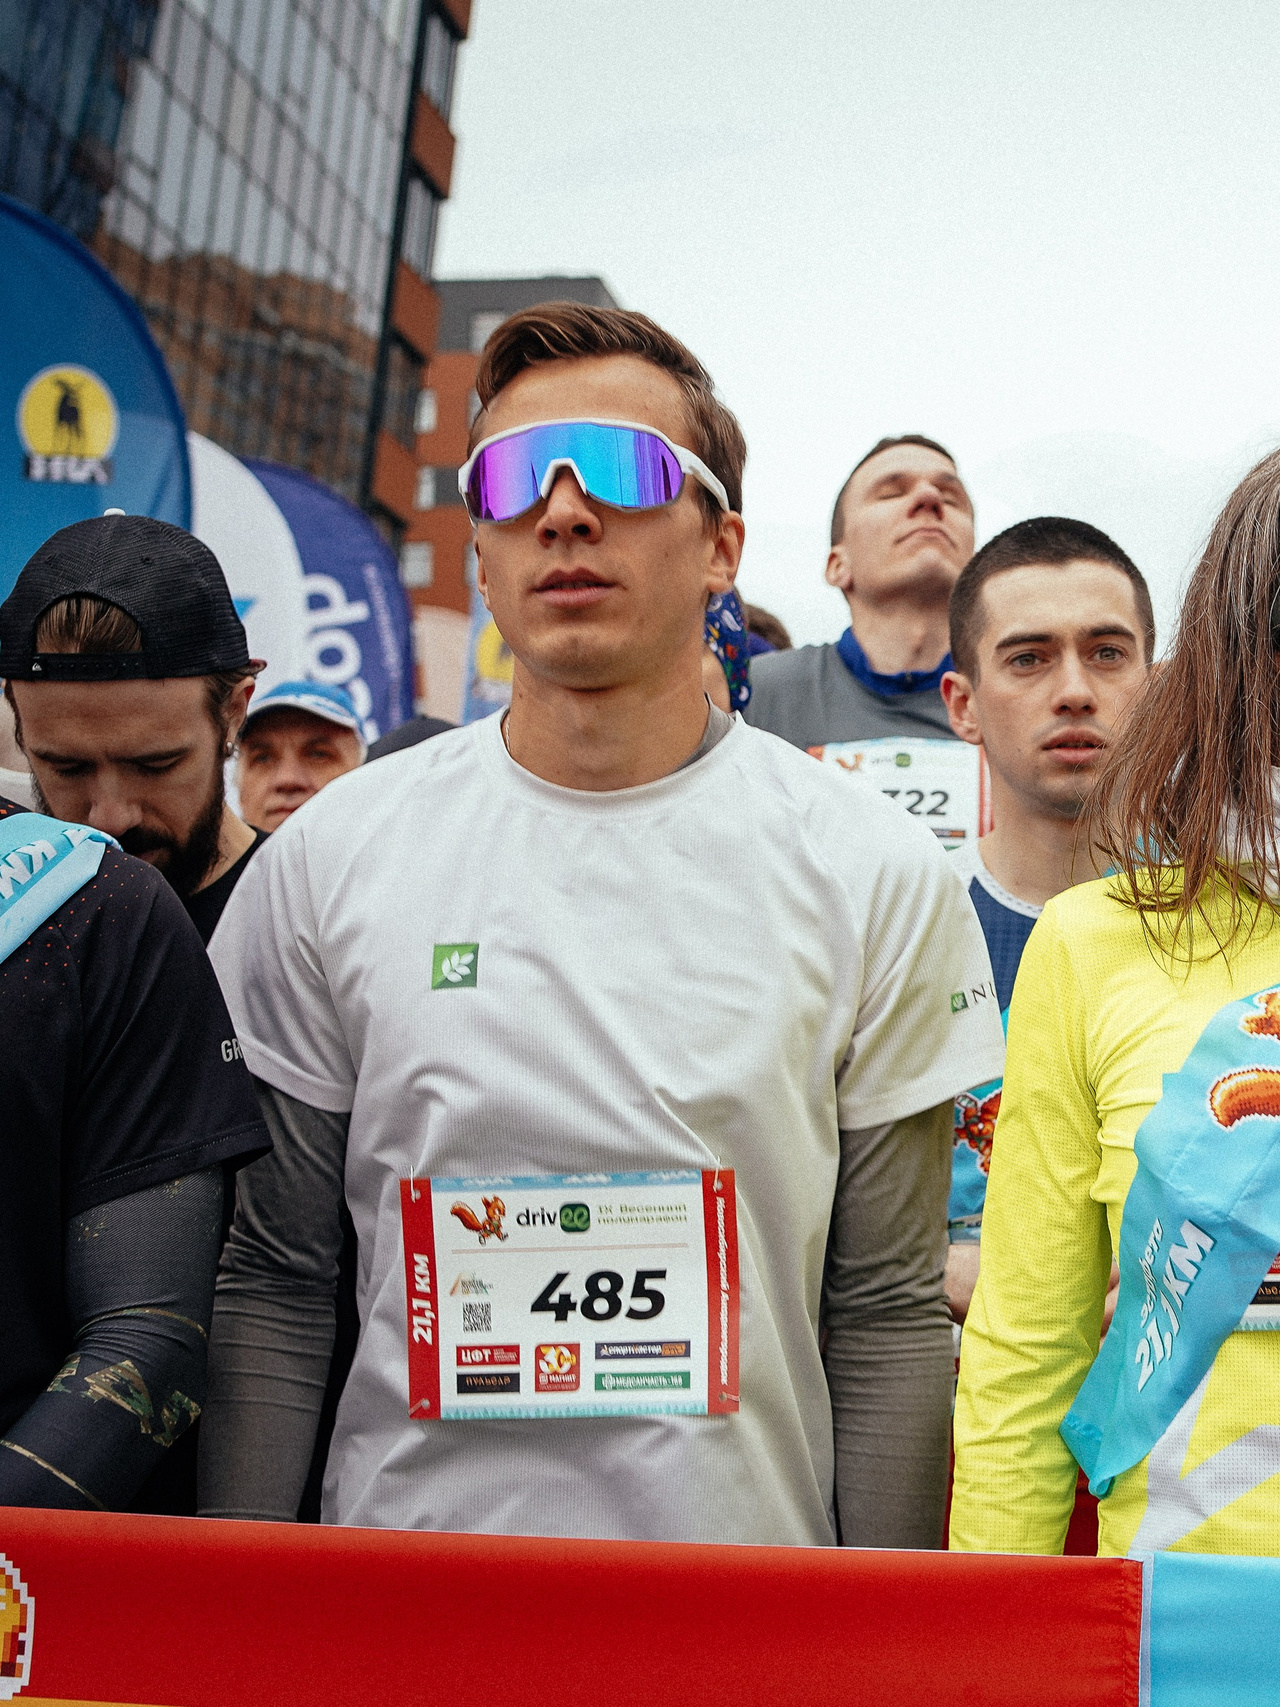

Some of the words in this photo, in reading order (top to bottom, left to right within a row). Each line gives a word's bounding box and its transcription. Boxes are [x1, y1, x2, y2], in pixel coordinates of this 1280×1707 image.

[516, 1205, 590, 1231] drivee
[412, 1253, 432, 1294] КМ
[530, 1268, 667, 1323] 485
[411, 1298, 436, 1346] 21,1
[461, 1348, 492, 1363] ЦФТ
